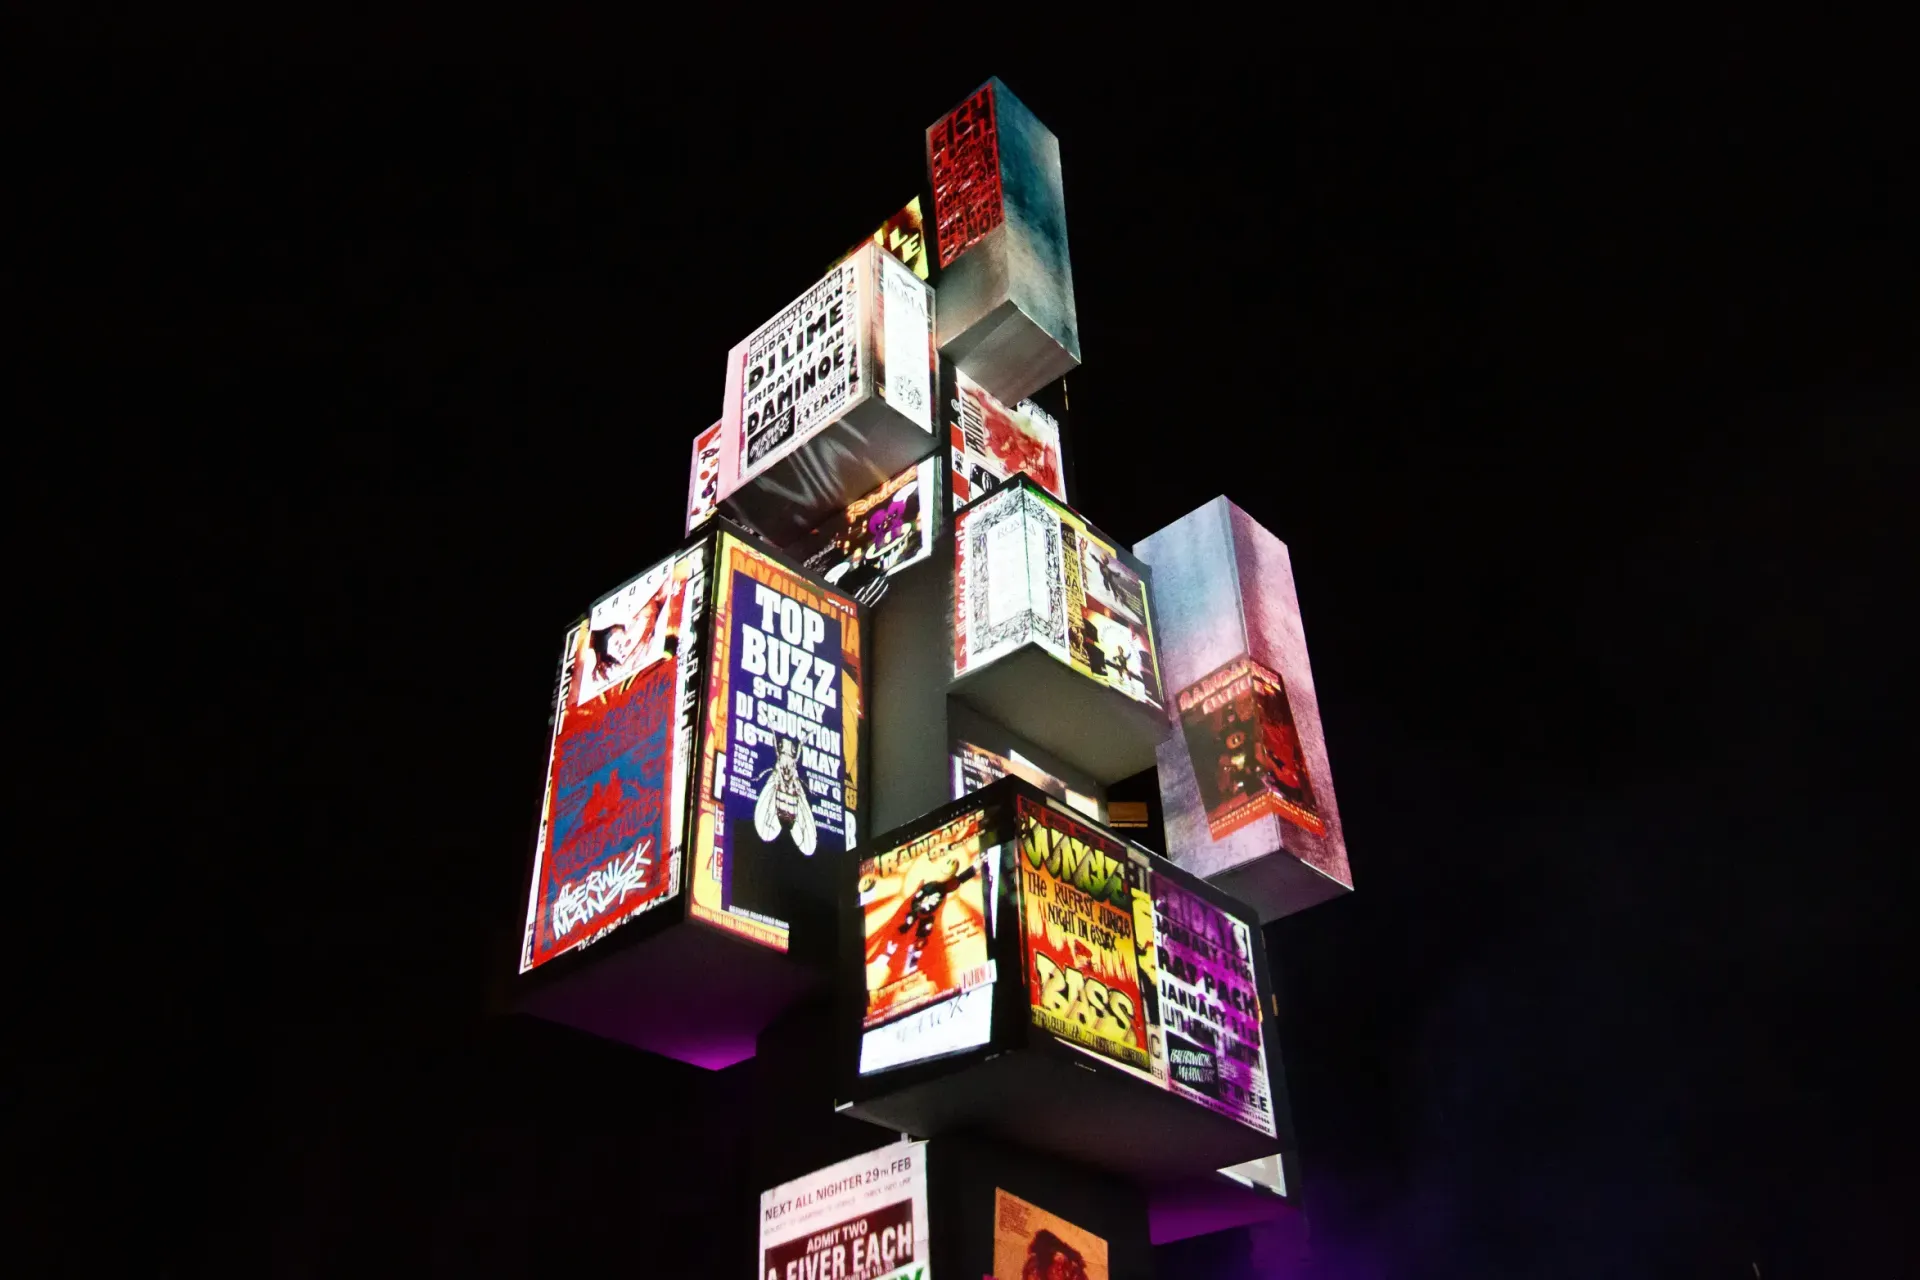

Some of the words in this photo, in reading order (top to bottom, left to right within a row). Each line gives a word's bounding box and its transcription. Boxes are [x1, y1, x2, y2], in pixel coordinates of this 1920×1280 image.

[748, 353, 776, 394] DJ
[781, 299, 844, 367] LIME
[749, 324, 795, 367] FRIDAY
[799, 310, 813, 328] 10
[819, 285, 843, 311] JAN
[747, 365, 795, 410] FRIDAY
[799, 351, 812, 370] 17
[820, 327, 844, 353] JAN
[747, 343, 845, 437] DAMINOE
[814, 381, 846, 412] EACH
[755, 583, 825, 653] TOP
[741, 623, 836, 709] BUZZ
[735, 690, 753, 720] DJ
[757, 701, 840, 757] SEDUCTION
[753, 676, 782, 700] 9TH
[787, 690, 825, 723] MAY
[734, 743, 750, 756] TWO
[735, 719, 774, 747] 16TH
[802, 746, 840, 779] MAY
[812, 804, 842, 821] ADAMS
[880, 809, 985, 878] RAINDANCE
[1047, 903, 1076, 935] NIGHT
[1036, 953, 1137, 1048] BASS
[1160, 977, 1227, 1029] JANUARY
[765, 1200, 792, 1221] NEXT
[795, 1193, 814, 1210] ALL
[816, 1174, 863, 1201] NIGHTER
[865, 1167, 889, 1185] 29TH
[891, 1156, 912, 1176] FEB
[806, 1227, 840, 1255] ADMIT
[842, 1218, 868, 1241] TWO
[853, 1220, 913, 1274] EACH
